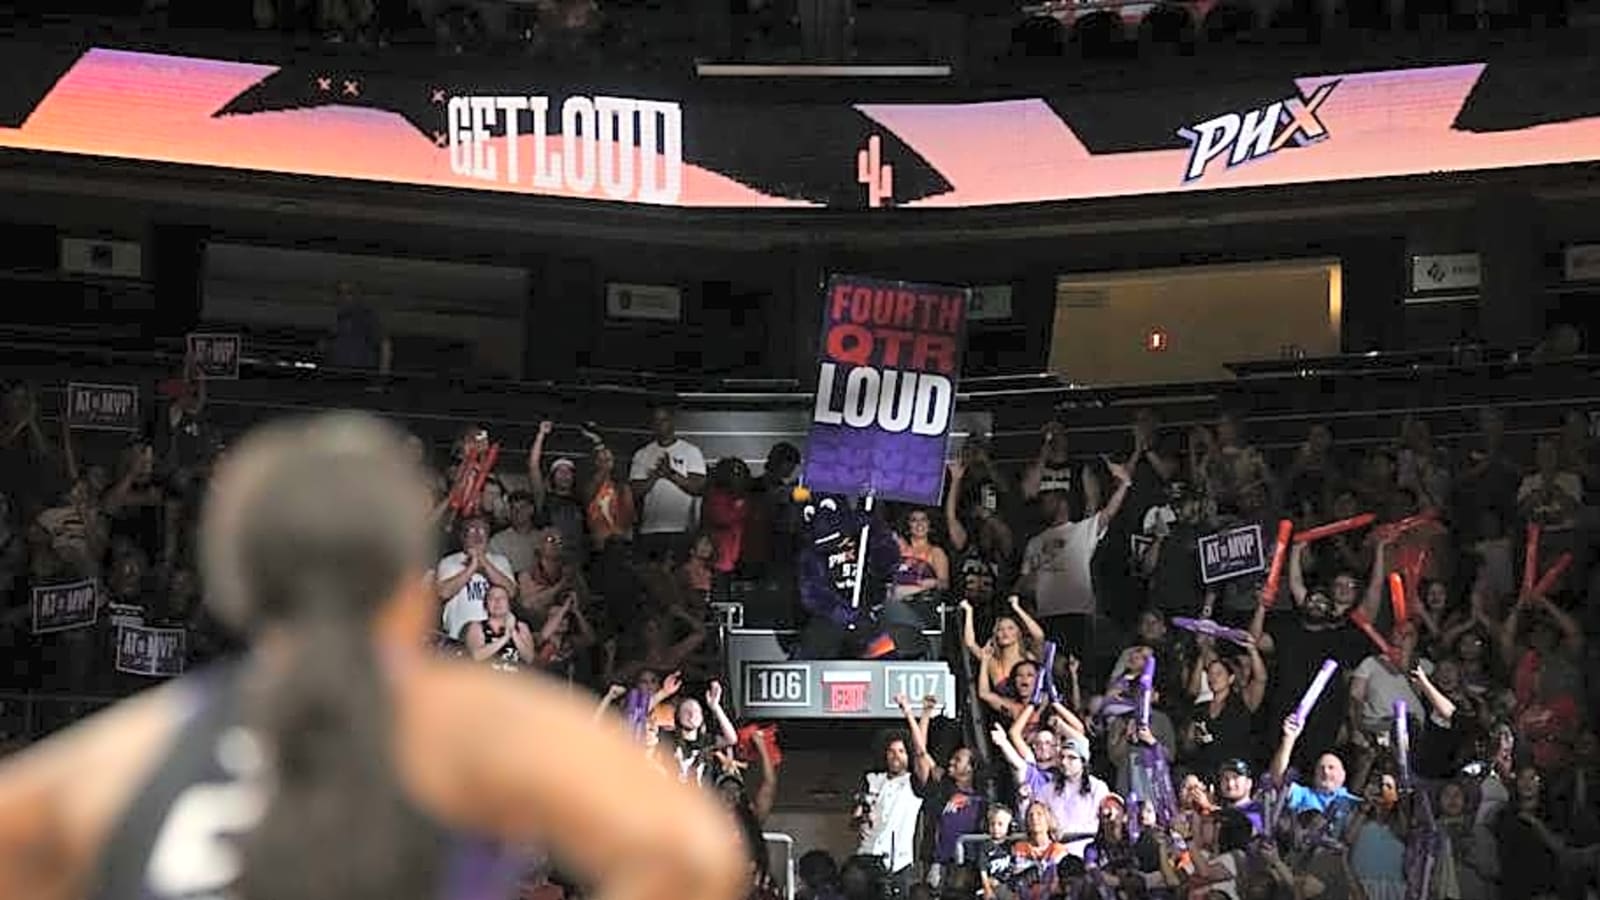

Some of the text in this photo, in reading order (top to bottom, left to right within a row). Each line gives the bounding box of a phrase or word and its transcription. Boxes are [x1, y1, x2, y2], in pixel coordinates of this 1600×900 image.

[448, 95, 682, 205] GET LOUD
[1177, 79, 1342, 183] PHX
[833, 285, 961, 330] FOURTH
[827, 323, 956, 375] QTR
[814, 362, 952, 436] LOUD
[1227, 533, 1254, 559] MVP
[758, 671, 801, 700] 106
[897, 673, 939, 701] 107
